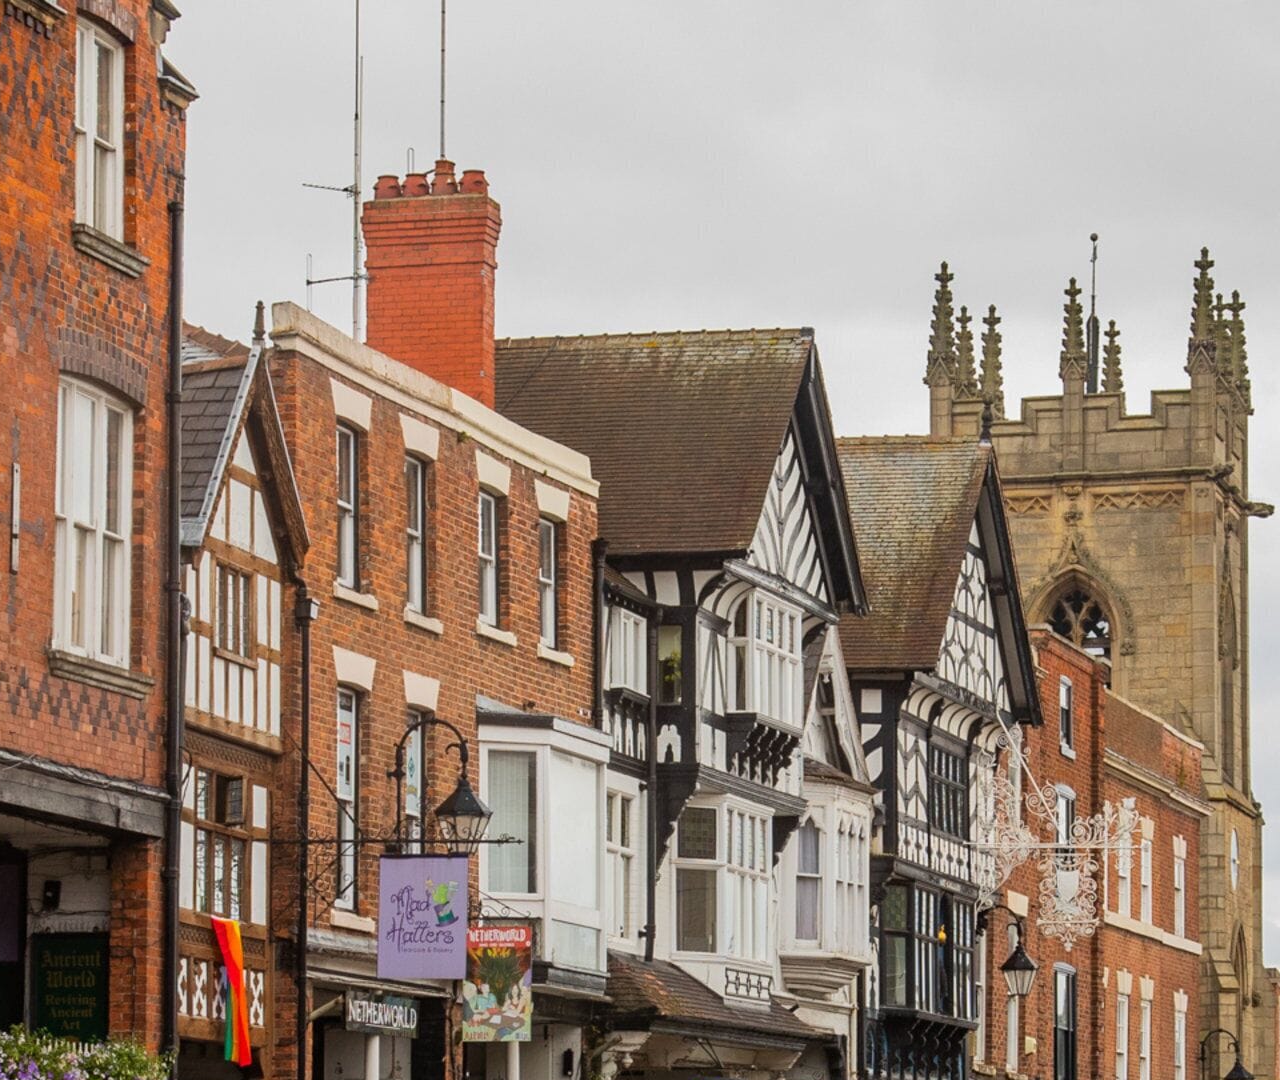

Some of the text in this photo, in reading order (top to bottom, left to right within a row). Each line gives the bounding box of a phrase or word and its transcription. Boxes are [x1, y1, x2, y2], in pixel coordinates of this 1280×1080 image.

[391, 885, 431, 925] Mad
[386, 914, 454, 951] Hatters
[469, 928, 526, 942] NETHERWORLD
[41, 951, 101, 968] Ancient
[46, 969, 97, 988] World
[348, 1000, 417, 1029] NETHERWORLD
